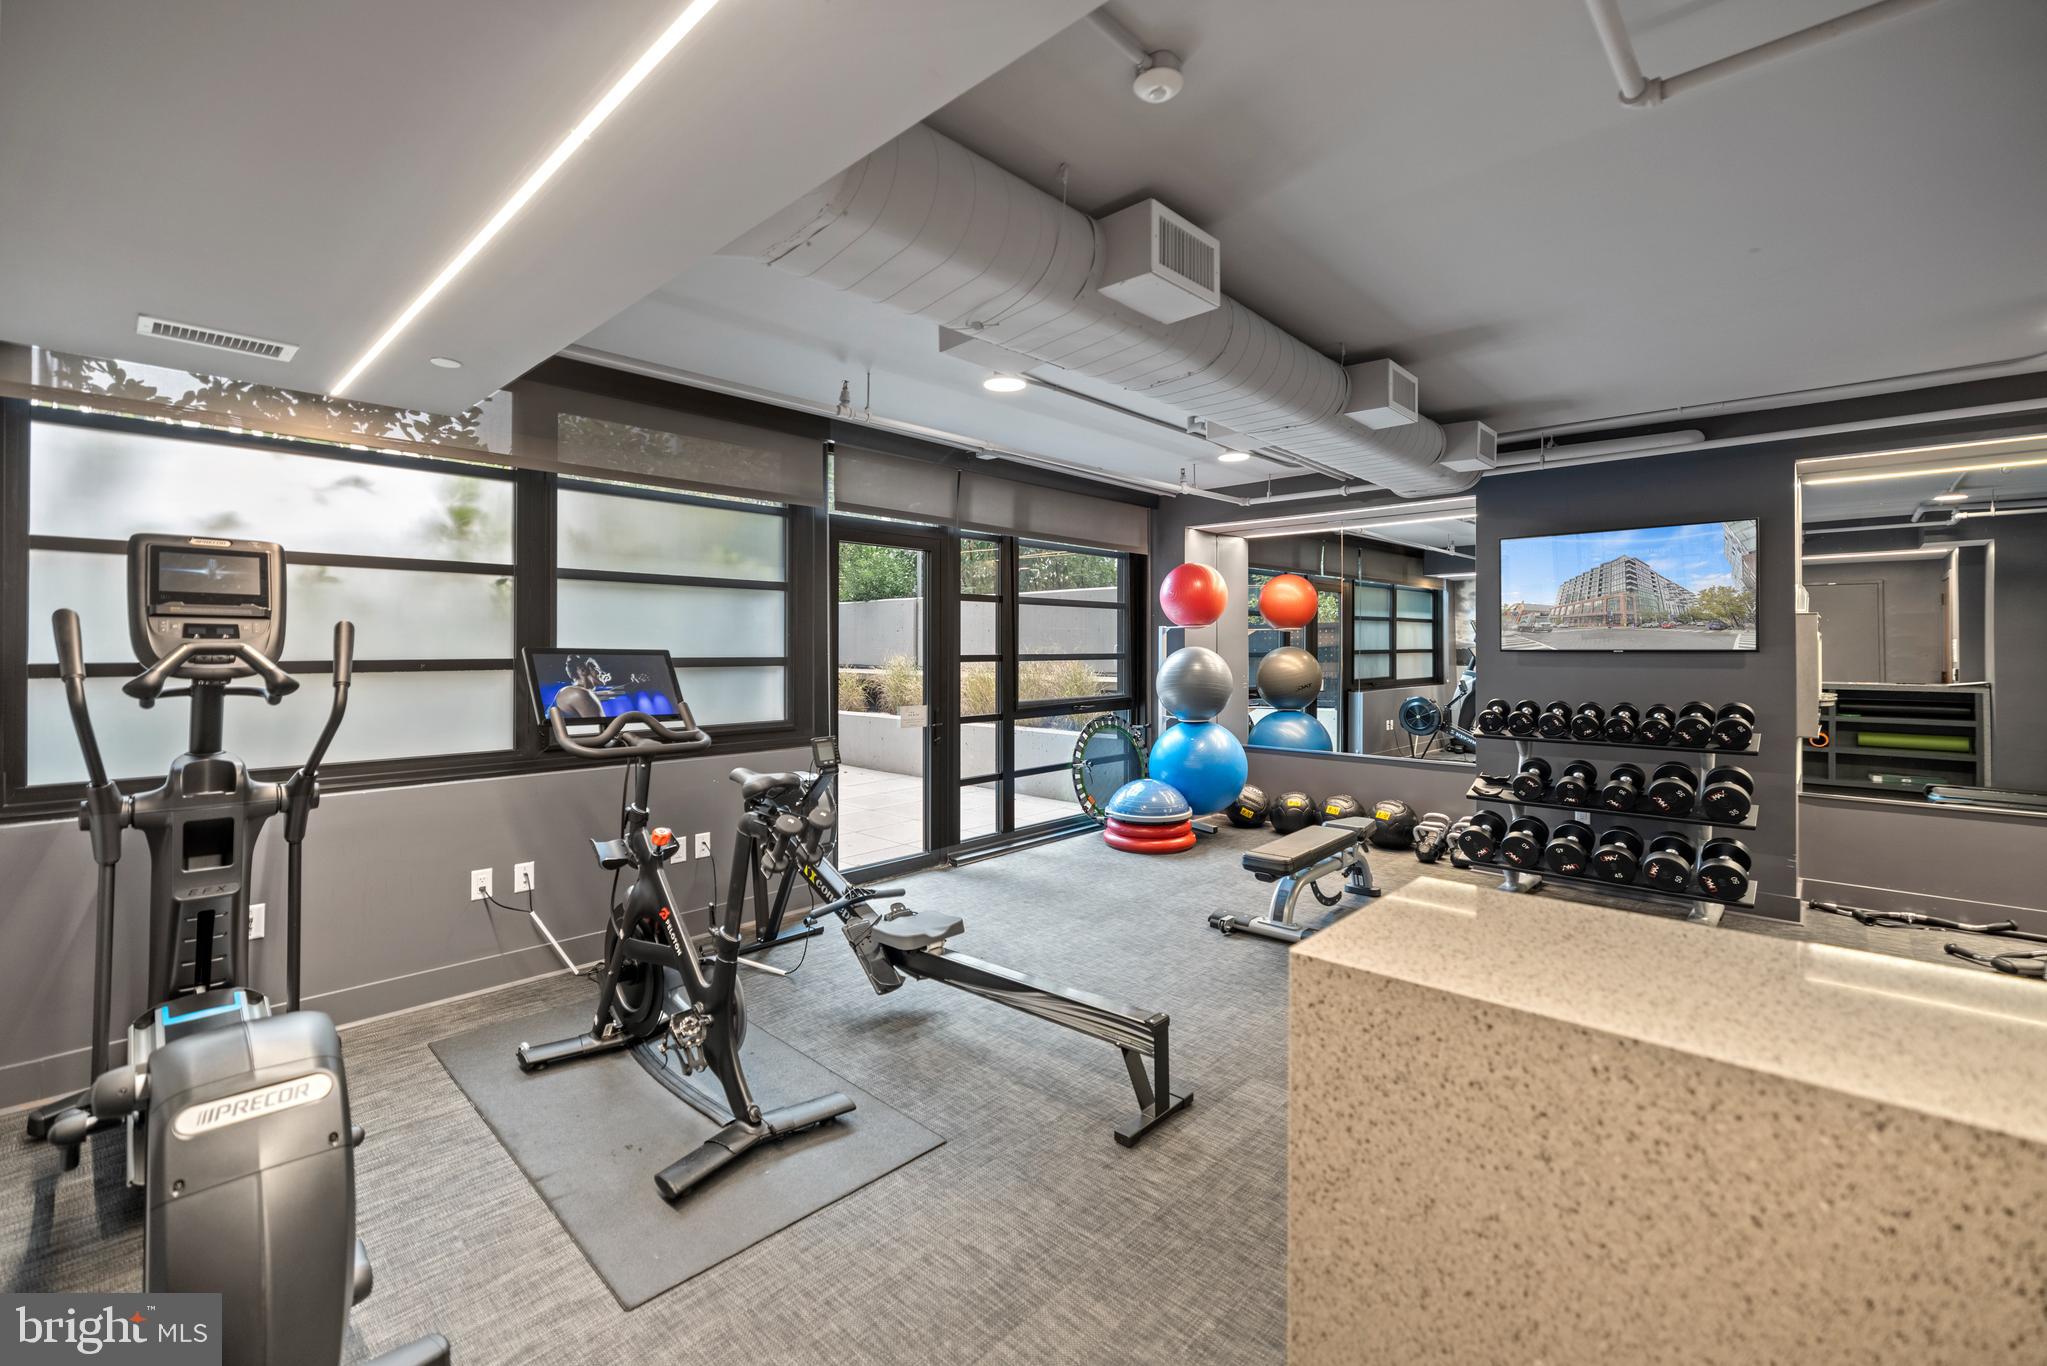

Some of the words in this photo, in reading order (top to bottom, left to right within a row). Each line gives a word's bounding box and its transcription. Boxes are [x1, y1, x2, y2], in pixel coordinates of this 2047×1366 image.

[1675, 789, 1686, 798] 35
[1728, 808, 1739, 816] 35
[1521, 842, 1530, 850] 40
[1730, 876, 1740, 885] 50
[665, 920, 682, 957] PELOTON
[214, 1082, 311, 1124] PRECOR
